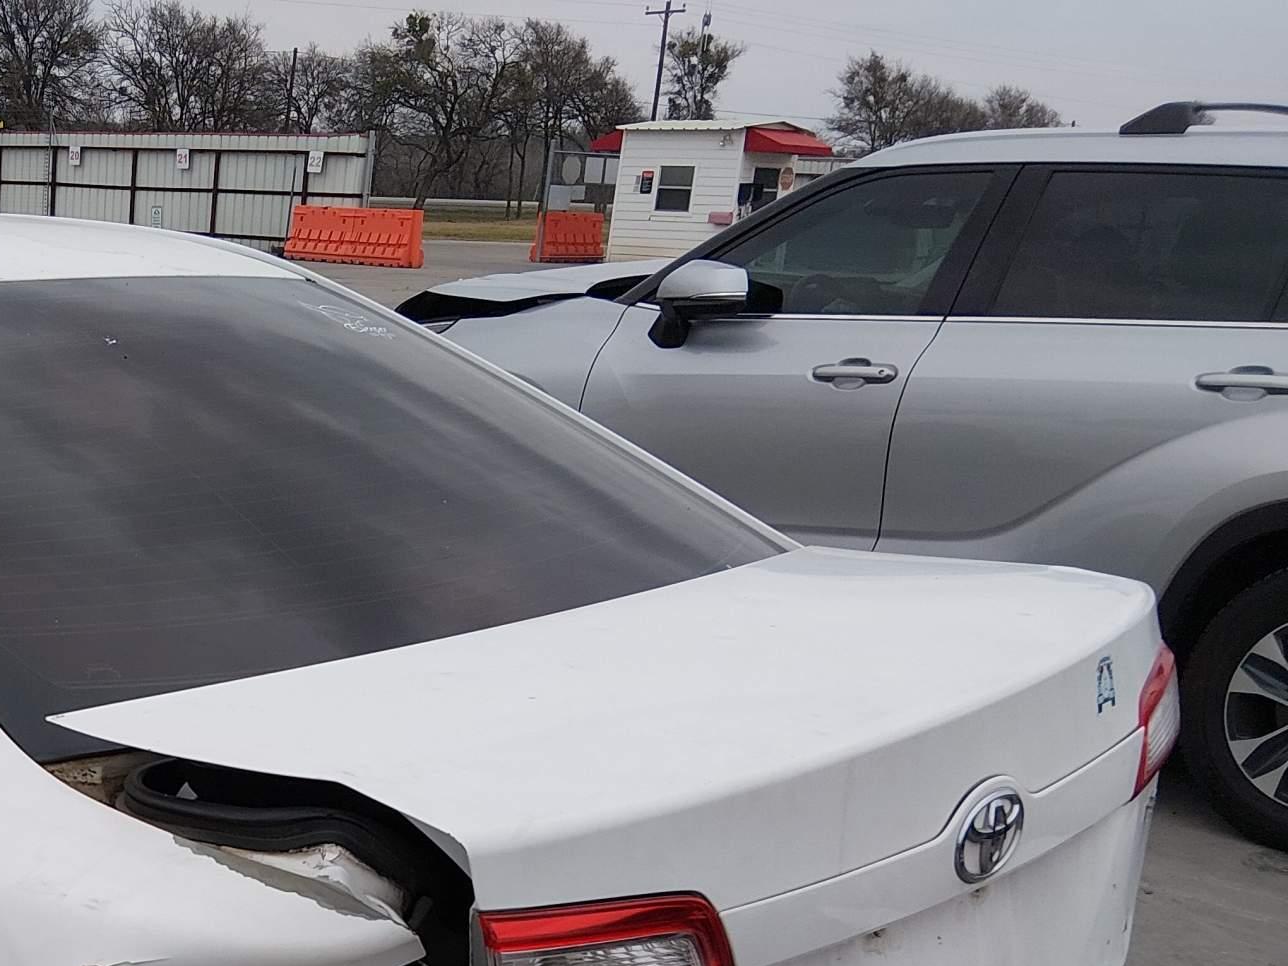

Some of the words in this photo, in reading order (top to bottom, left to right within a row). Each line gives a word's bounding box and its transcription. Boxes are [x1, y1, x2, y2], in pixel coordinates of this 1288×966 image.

[70, 150, 80, 161] 20
[177, 153, 187, 164] 21
[309, 156, 322, 168] 22
